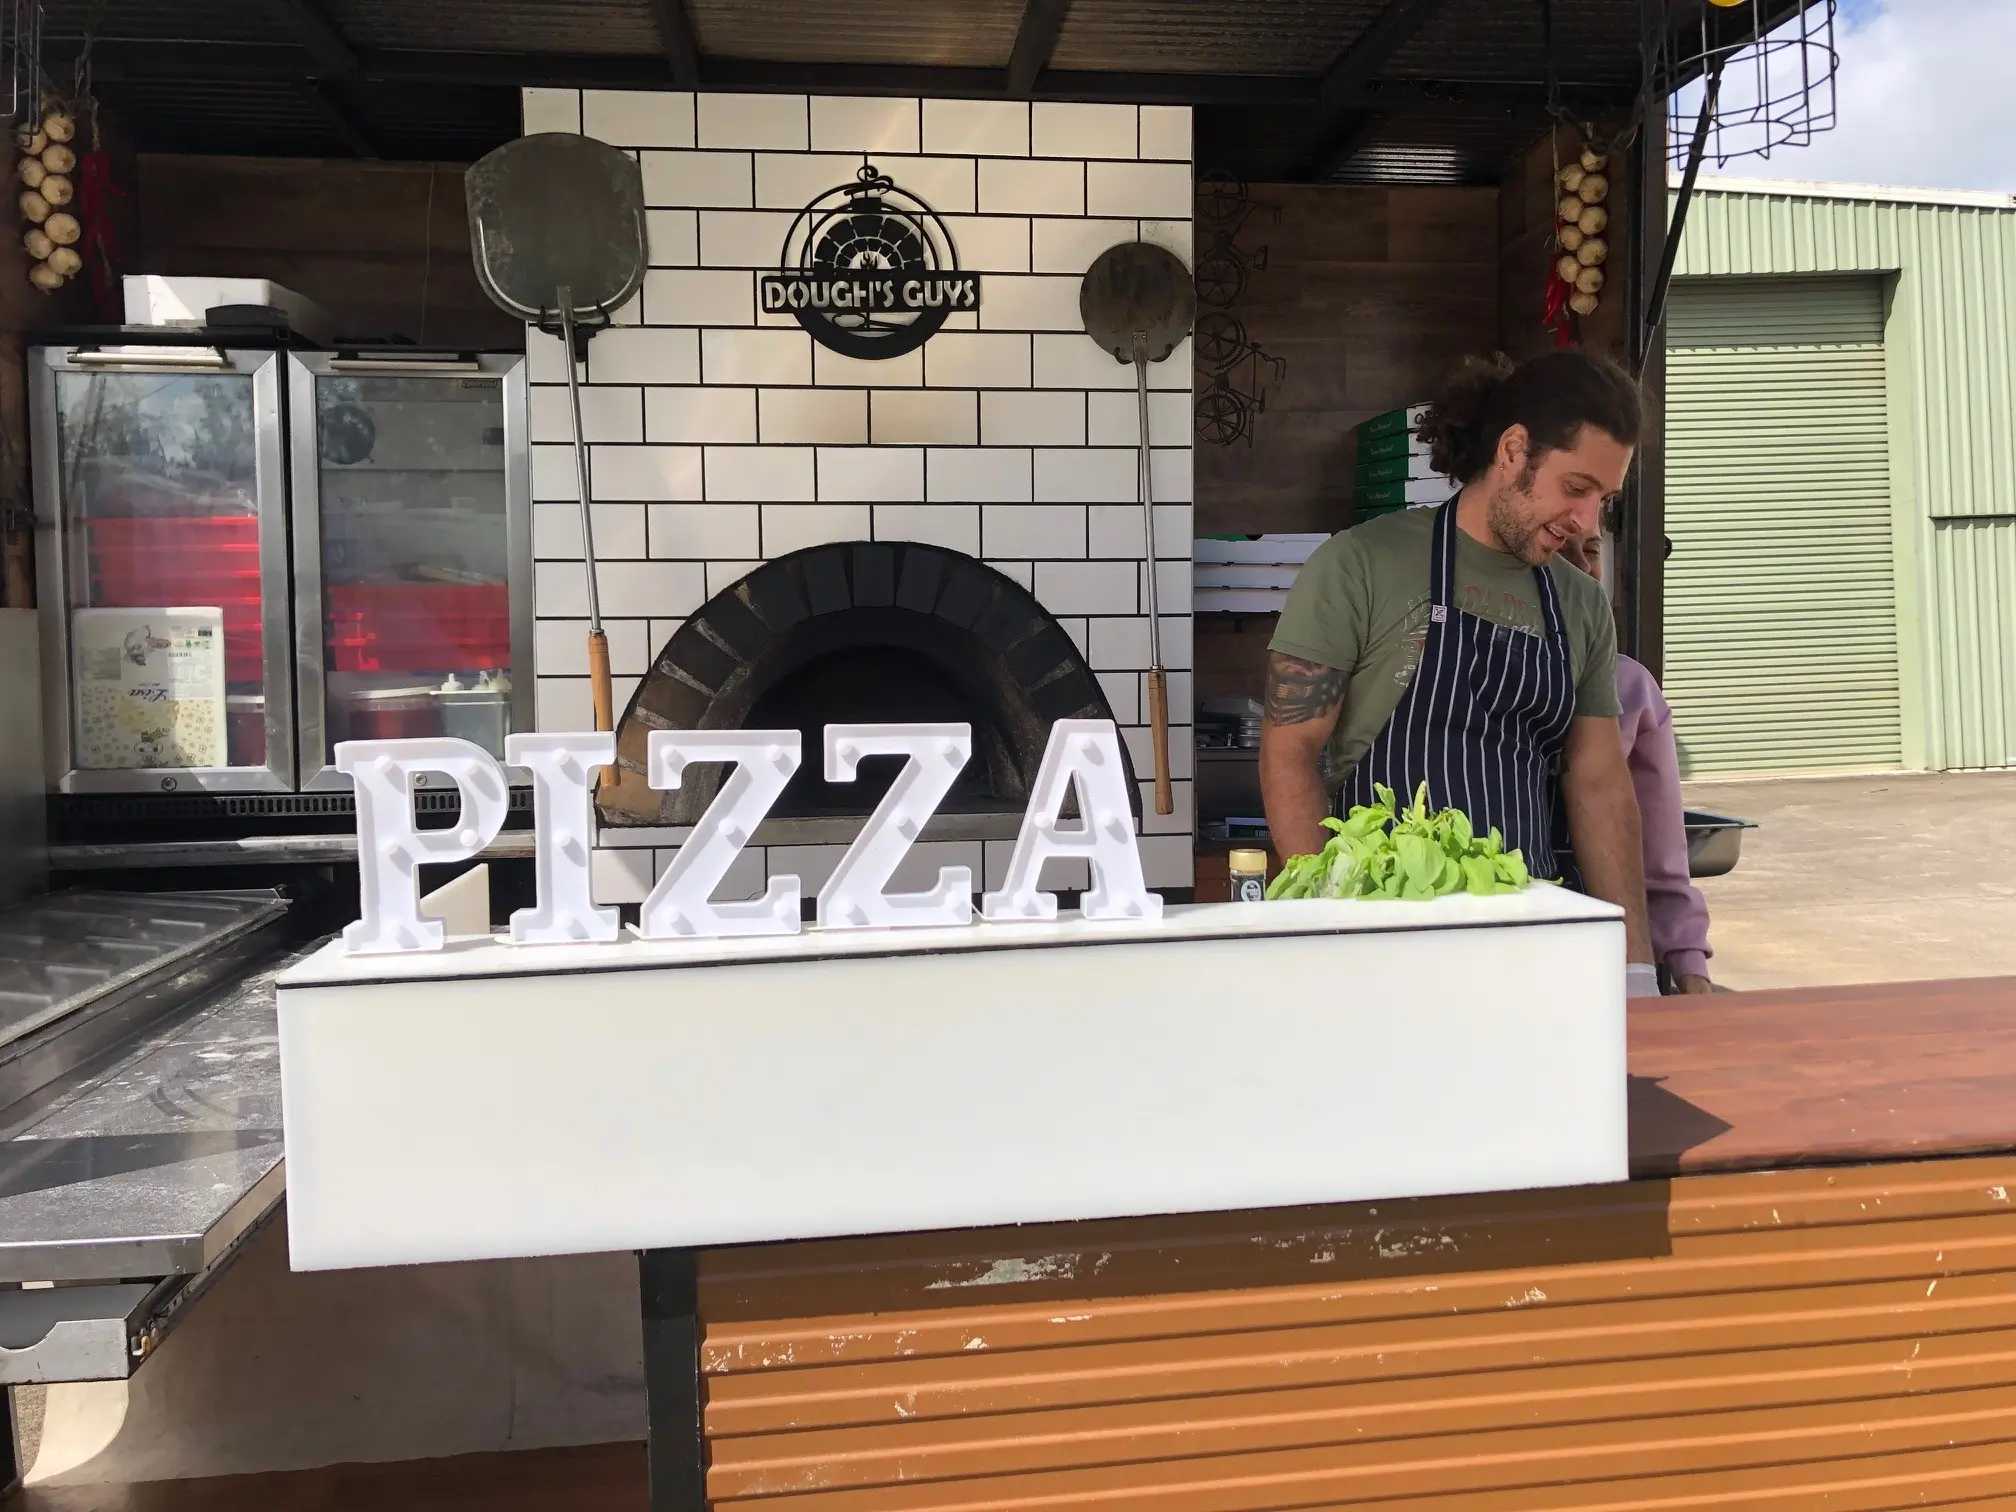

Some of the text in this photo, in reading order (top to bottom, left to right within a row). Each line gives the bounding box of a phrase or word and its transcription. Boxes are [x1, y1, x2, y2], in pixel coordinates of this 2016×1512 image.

[765, 279, 975, 309] DOUGH'S GUYS
[334, 718, 1164, 957] PIZZA
